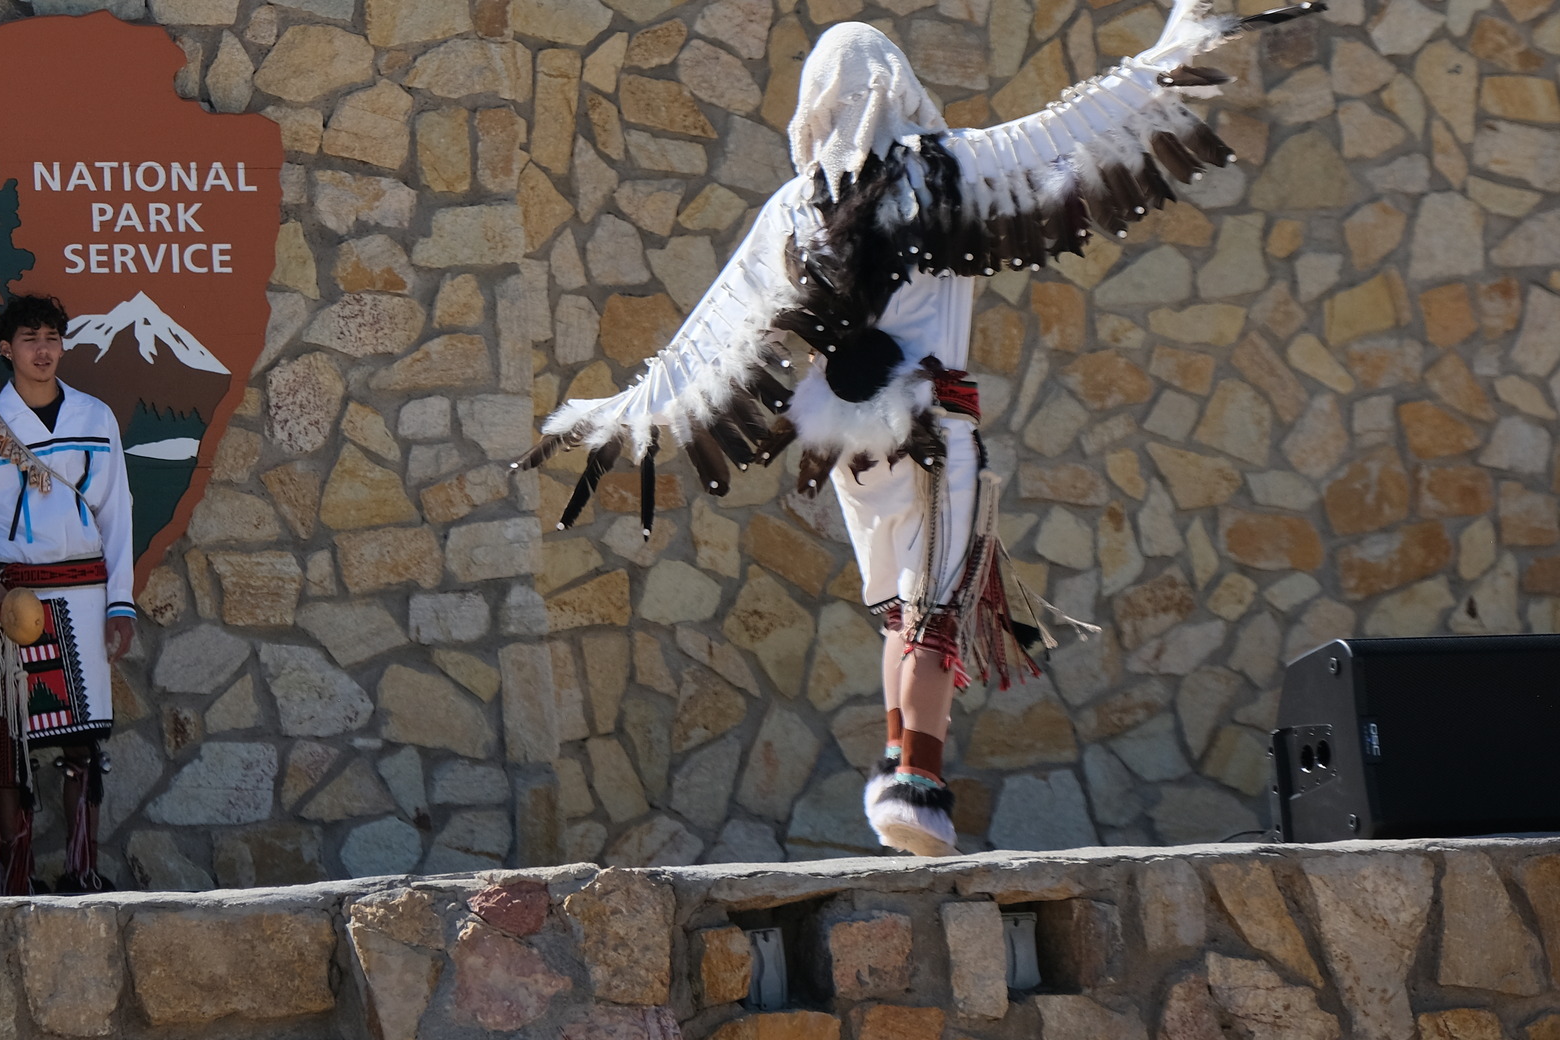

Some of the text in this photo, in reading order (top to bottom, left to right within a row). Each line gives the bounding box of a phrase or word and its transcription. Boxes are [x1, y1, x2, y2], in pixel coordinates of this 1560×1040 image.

[33, 161, 258, 192] NATIONAL
[91, 202, 205, 233] PARK
[63, 243, 233, 274] SERVICE
